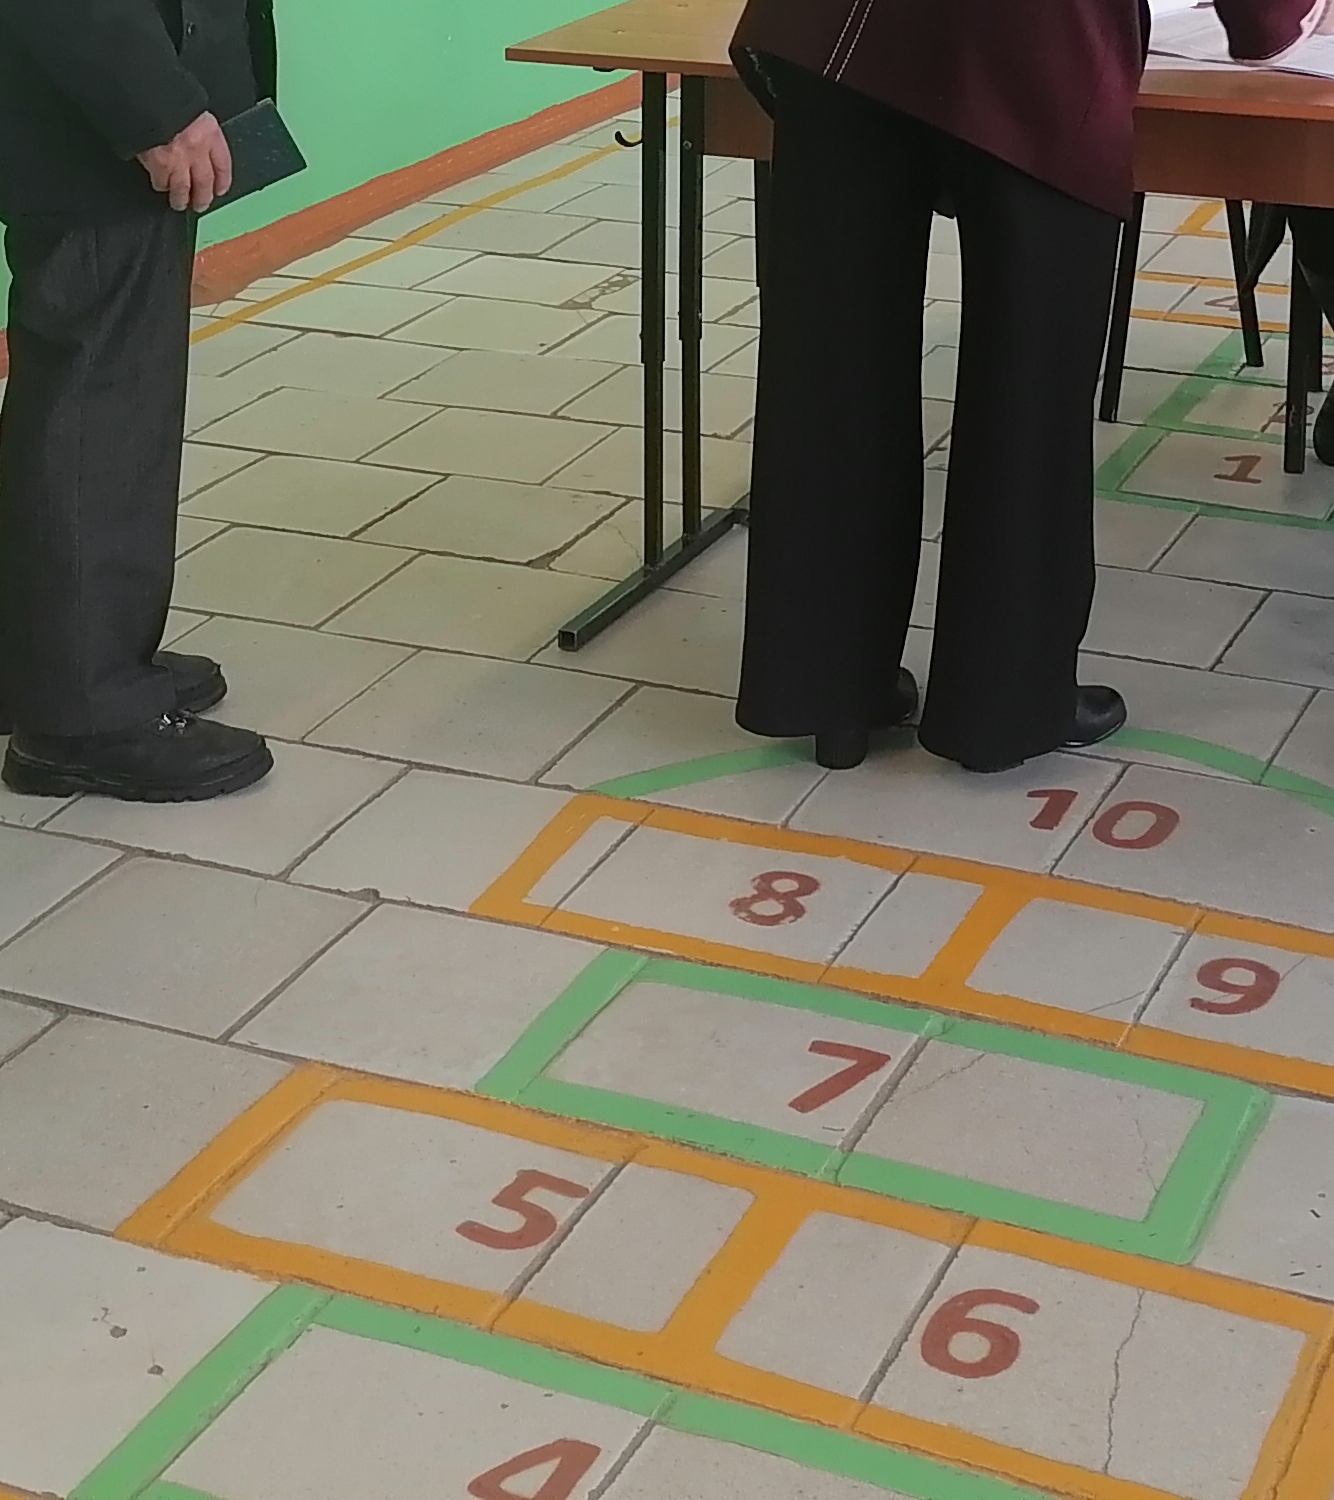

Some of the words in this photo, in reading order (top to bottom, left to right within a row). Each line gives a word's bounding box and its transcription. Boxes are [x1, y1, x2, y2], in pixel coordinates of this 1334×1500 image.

[1214, 454, 1263, 484] 1
[1027, 789, 1179, 849] 10
[729, 871, 820, 927] 8
[1188, 958, 1281, 1016] 9
[788, 1040, 891, 1113] 7
[455, 1170, 593, 1250] 5
[919, 1289, 1040, 1379] 6
[467, 1437, 602, 1500] 4
